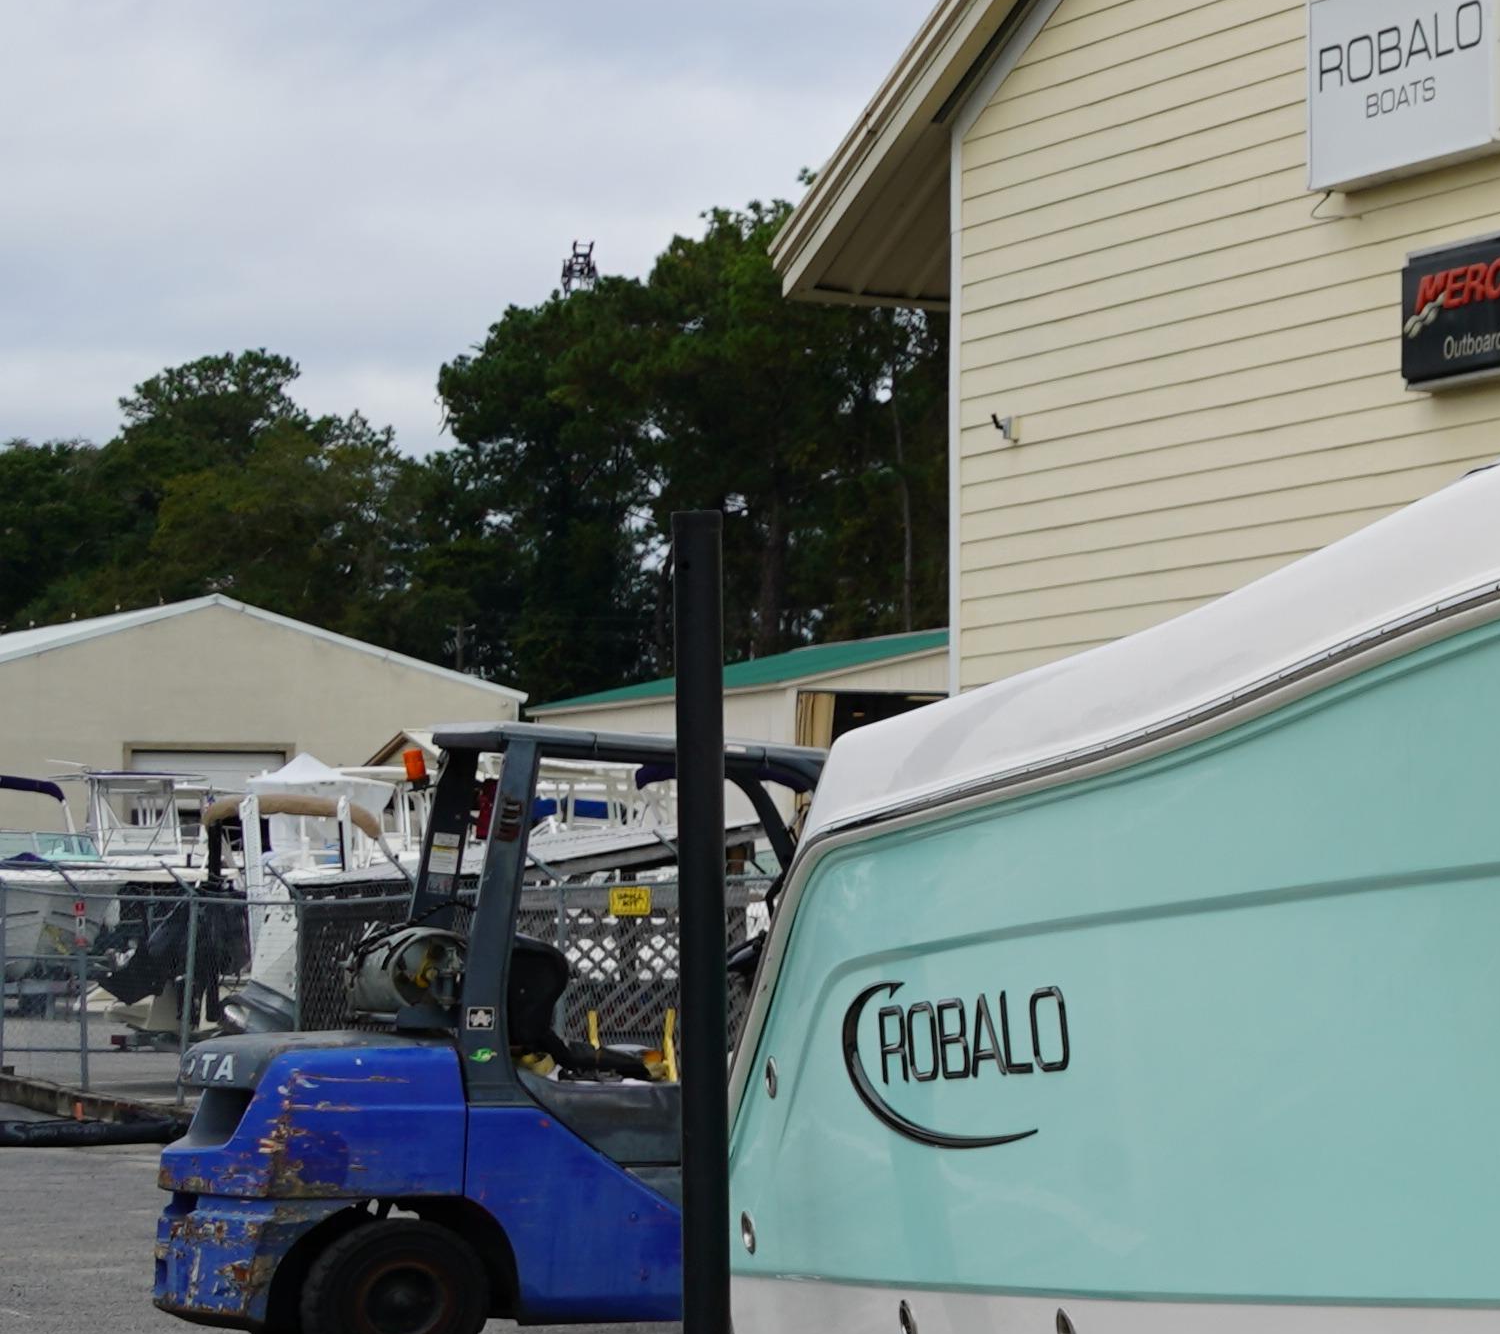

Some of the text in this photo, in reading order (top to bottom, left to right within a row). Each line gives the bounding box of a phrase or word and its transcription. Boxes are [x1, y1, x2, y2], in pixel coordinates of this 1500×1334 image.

[1318, 0, 1483, 93] ROBALO
[1366, 77, 1437, 118] BOATS
[878, 985, 1070, 1085] ROBALO
